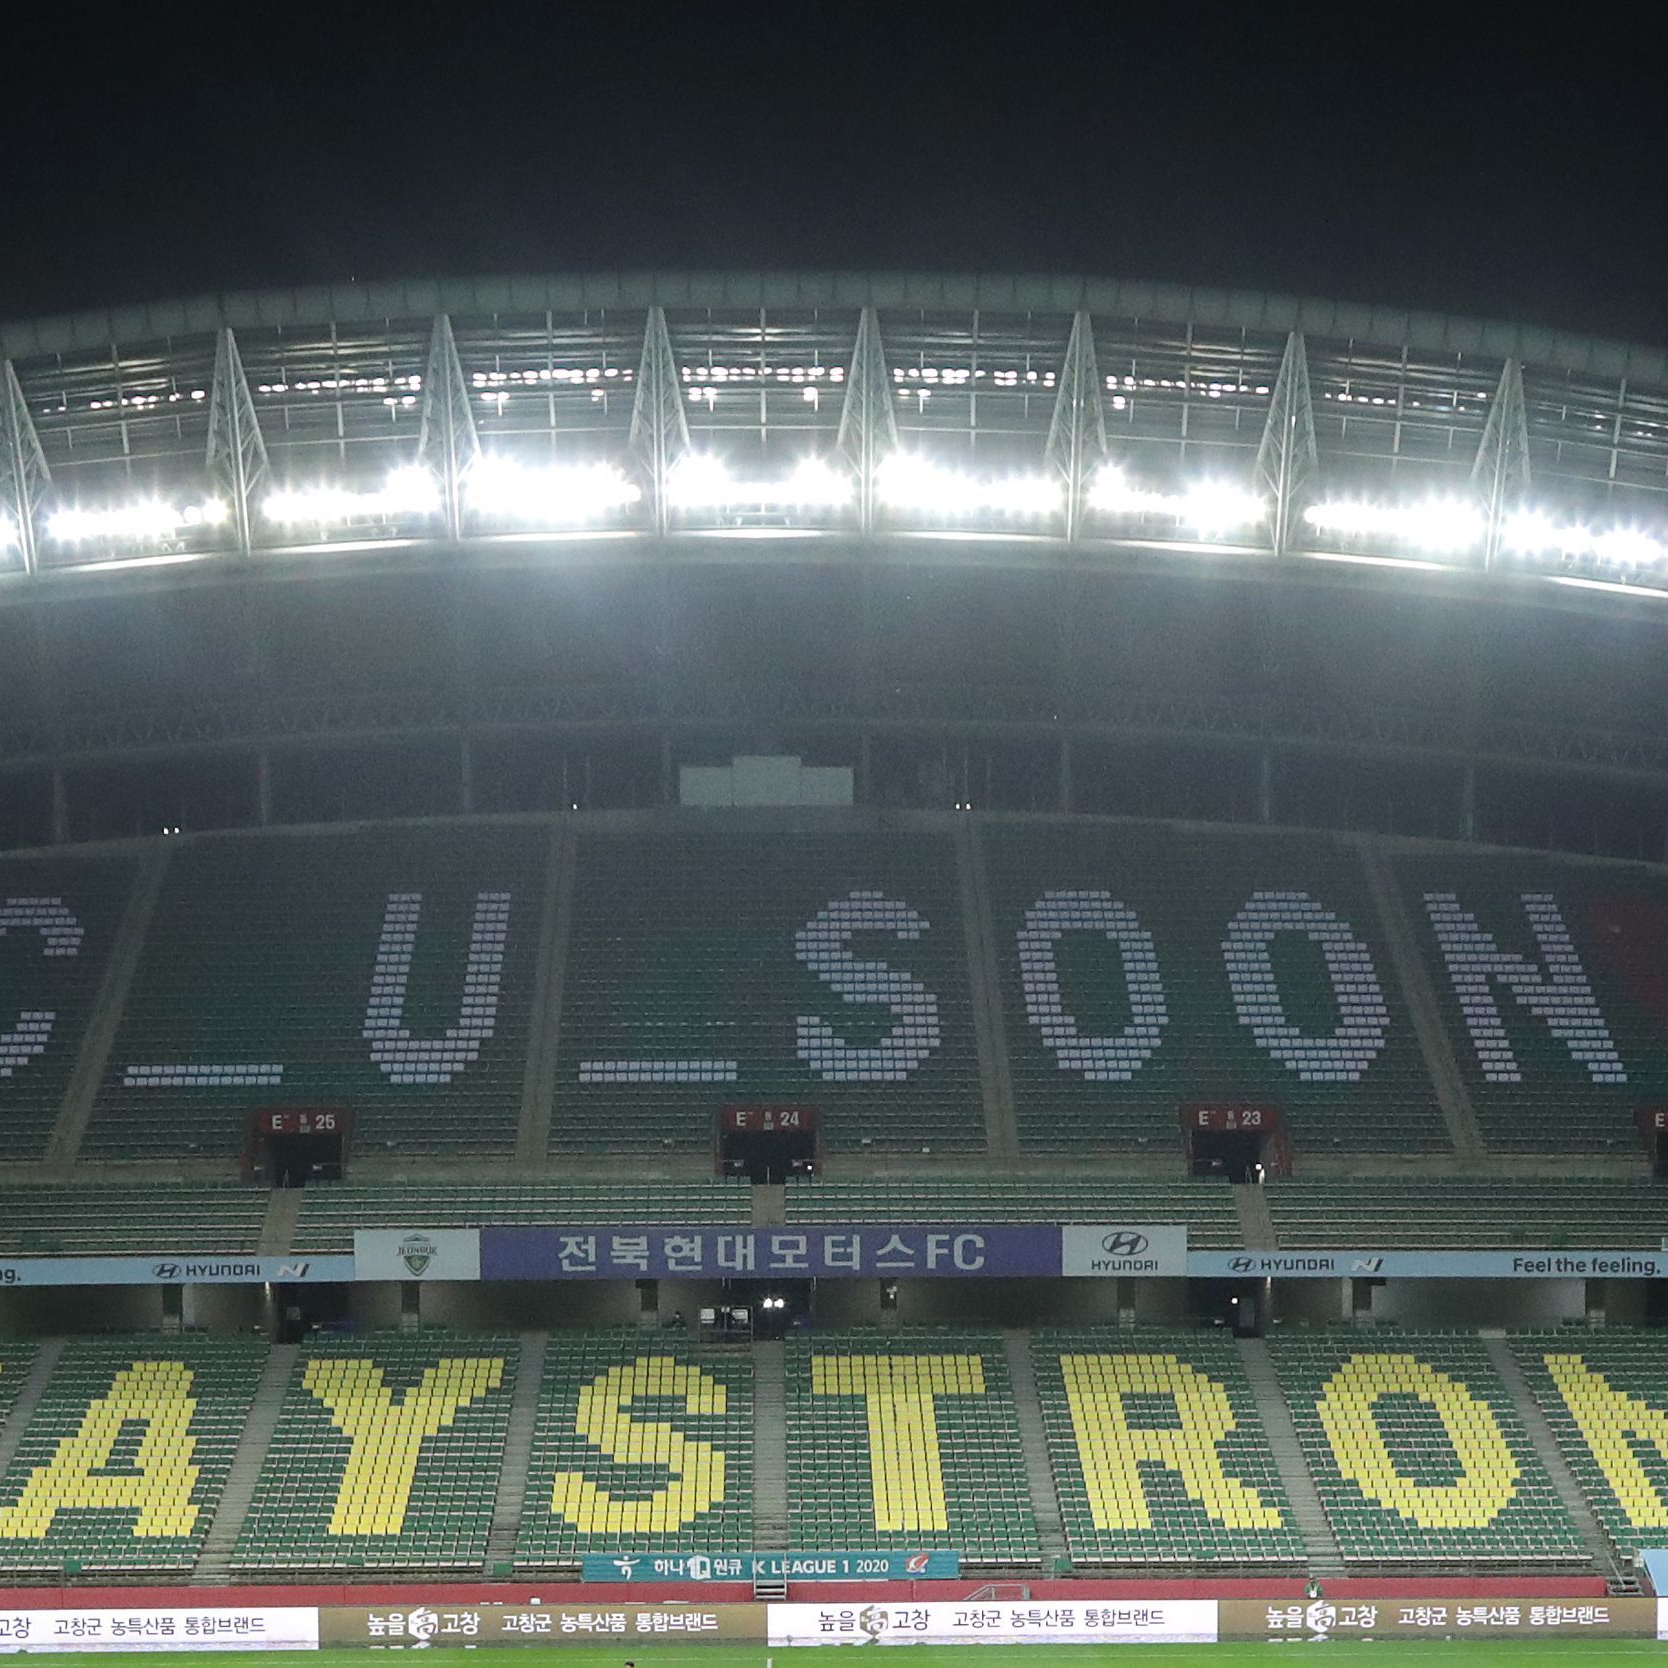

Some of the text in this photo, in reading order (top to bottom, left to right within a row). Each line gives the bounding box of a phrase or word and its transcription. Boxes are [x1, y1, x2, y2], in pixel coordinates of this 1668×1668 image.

[315, 1114, 335, 1129] 25
[780, 1112, 800, 1126] 24
[1241, 1111, 1262, 1126] 23
[397, 1245, 437, 1257] JEONBUK
[557, 1232, 985, 1272] 전북현대모터스FC
[186, 1264, 260, 1277] HYUNDAI
[1091, 1259, 1159, 1271] HYUNDAI
[1260, 1258, 1334, 1271] HYUNDAI
[1513, 1257, 1661, 1276] Feel the feeling.
[753, 1560, 764, 1574] K
[772, 1560, 836, 1574] LEAGUE
[843, 1560, 849, 1574] 1
[856, 1559, 889, 1573] 2020
[501, 1612, 551, 1634] 고창군
[561, 1612, 625, 1634] 농특산품
[636, 1612, 718, 1634] 통합브랜드
[953, 1608, 1001, 1630] 고창군
[1011, 1608, 1074, 1630] 농특산품
[1084, 1608, 1165, 1630] 통합브랜드
[1399, 1606, 1447, 1627] 고창군
[1456, 1606, 1520, 1627] 농특산품
[1529, 1606, 1609, 1627] 통합브랜드
[54, 1616, 102, 1638] 고창군
[111, 1616, 175, 1638] 농특산품
[184, 1616, 265, 1638] 통합브랜드
